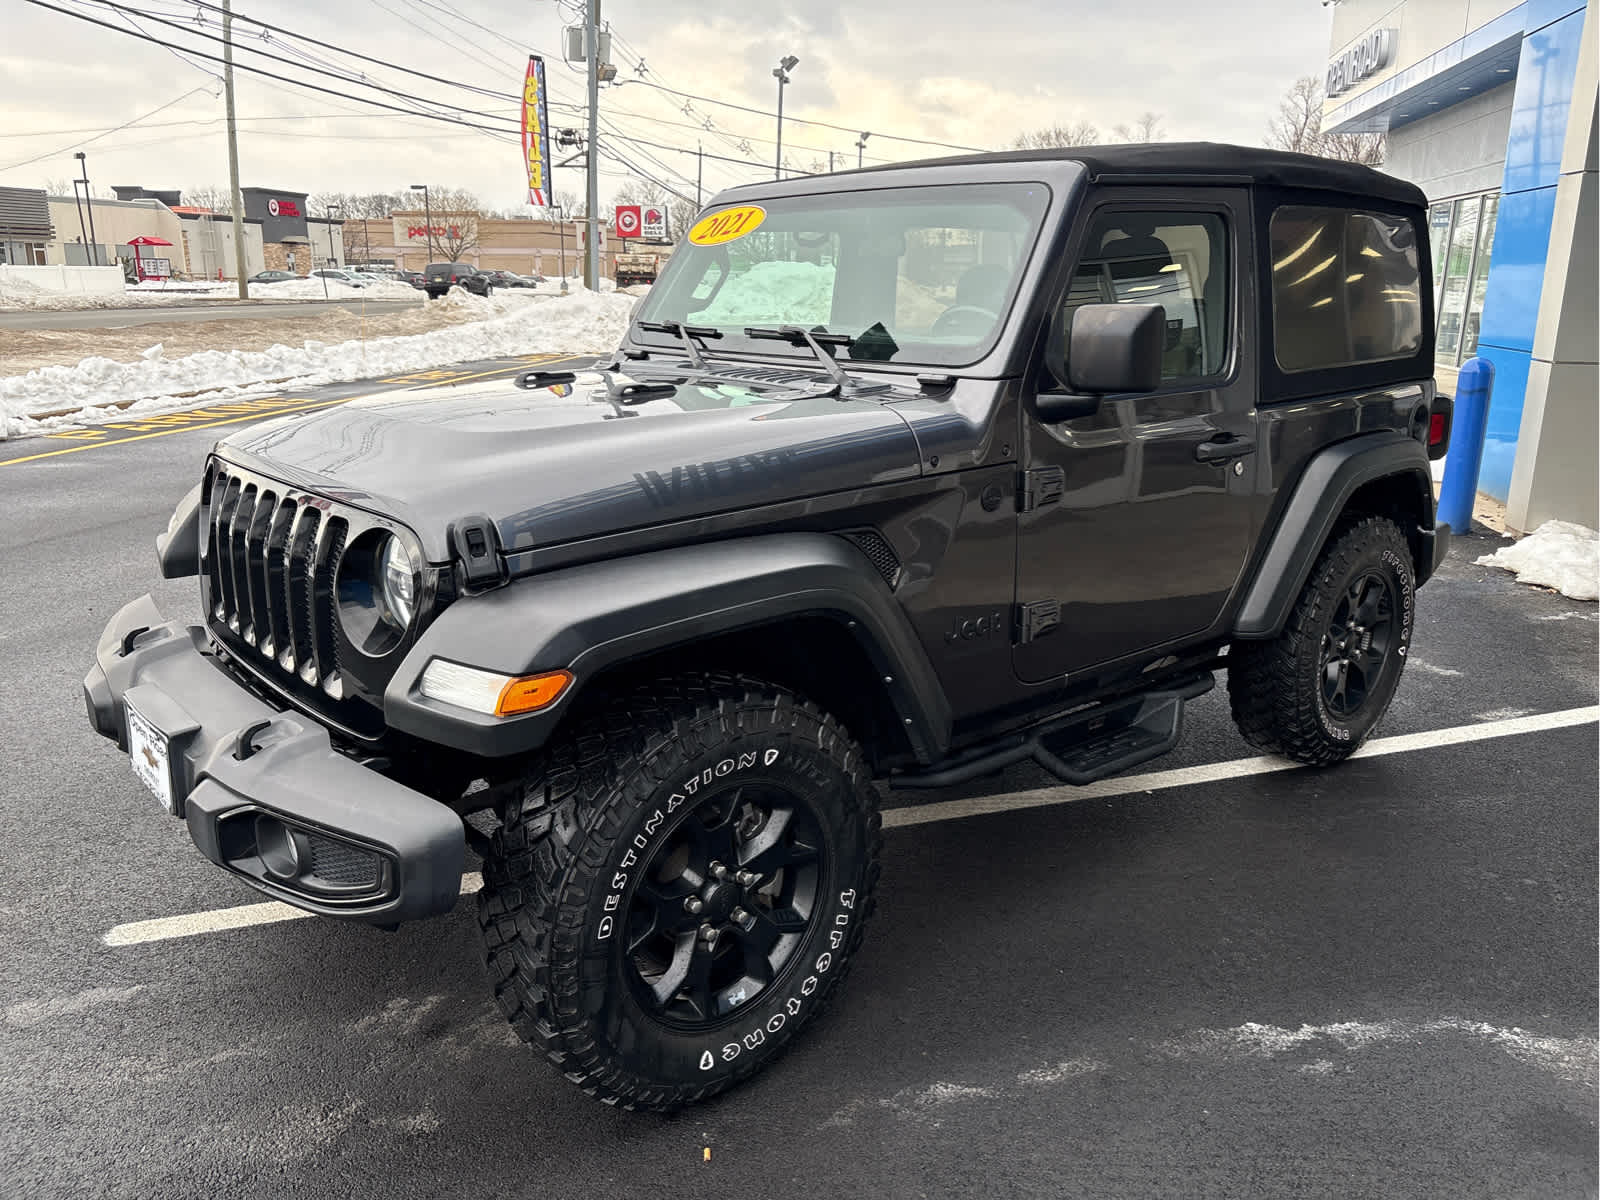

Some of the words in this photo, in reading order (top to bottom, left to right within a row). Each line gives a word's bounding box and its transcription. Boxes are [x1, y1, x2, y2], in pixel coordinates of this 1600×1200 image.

[1326, 50, 1353, 98] OPEN
[1352, 29, 1388, 82] ROAD
[696, 210, 755, 240] 2021
[597, 751, 757, 940] DESTINATION
